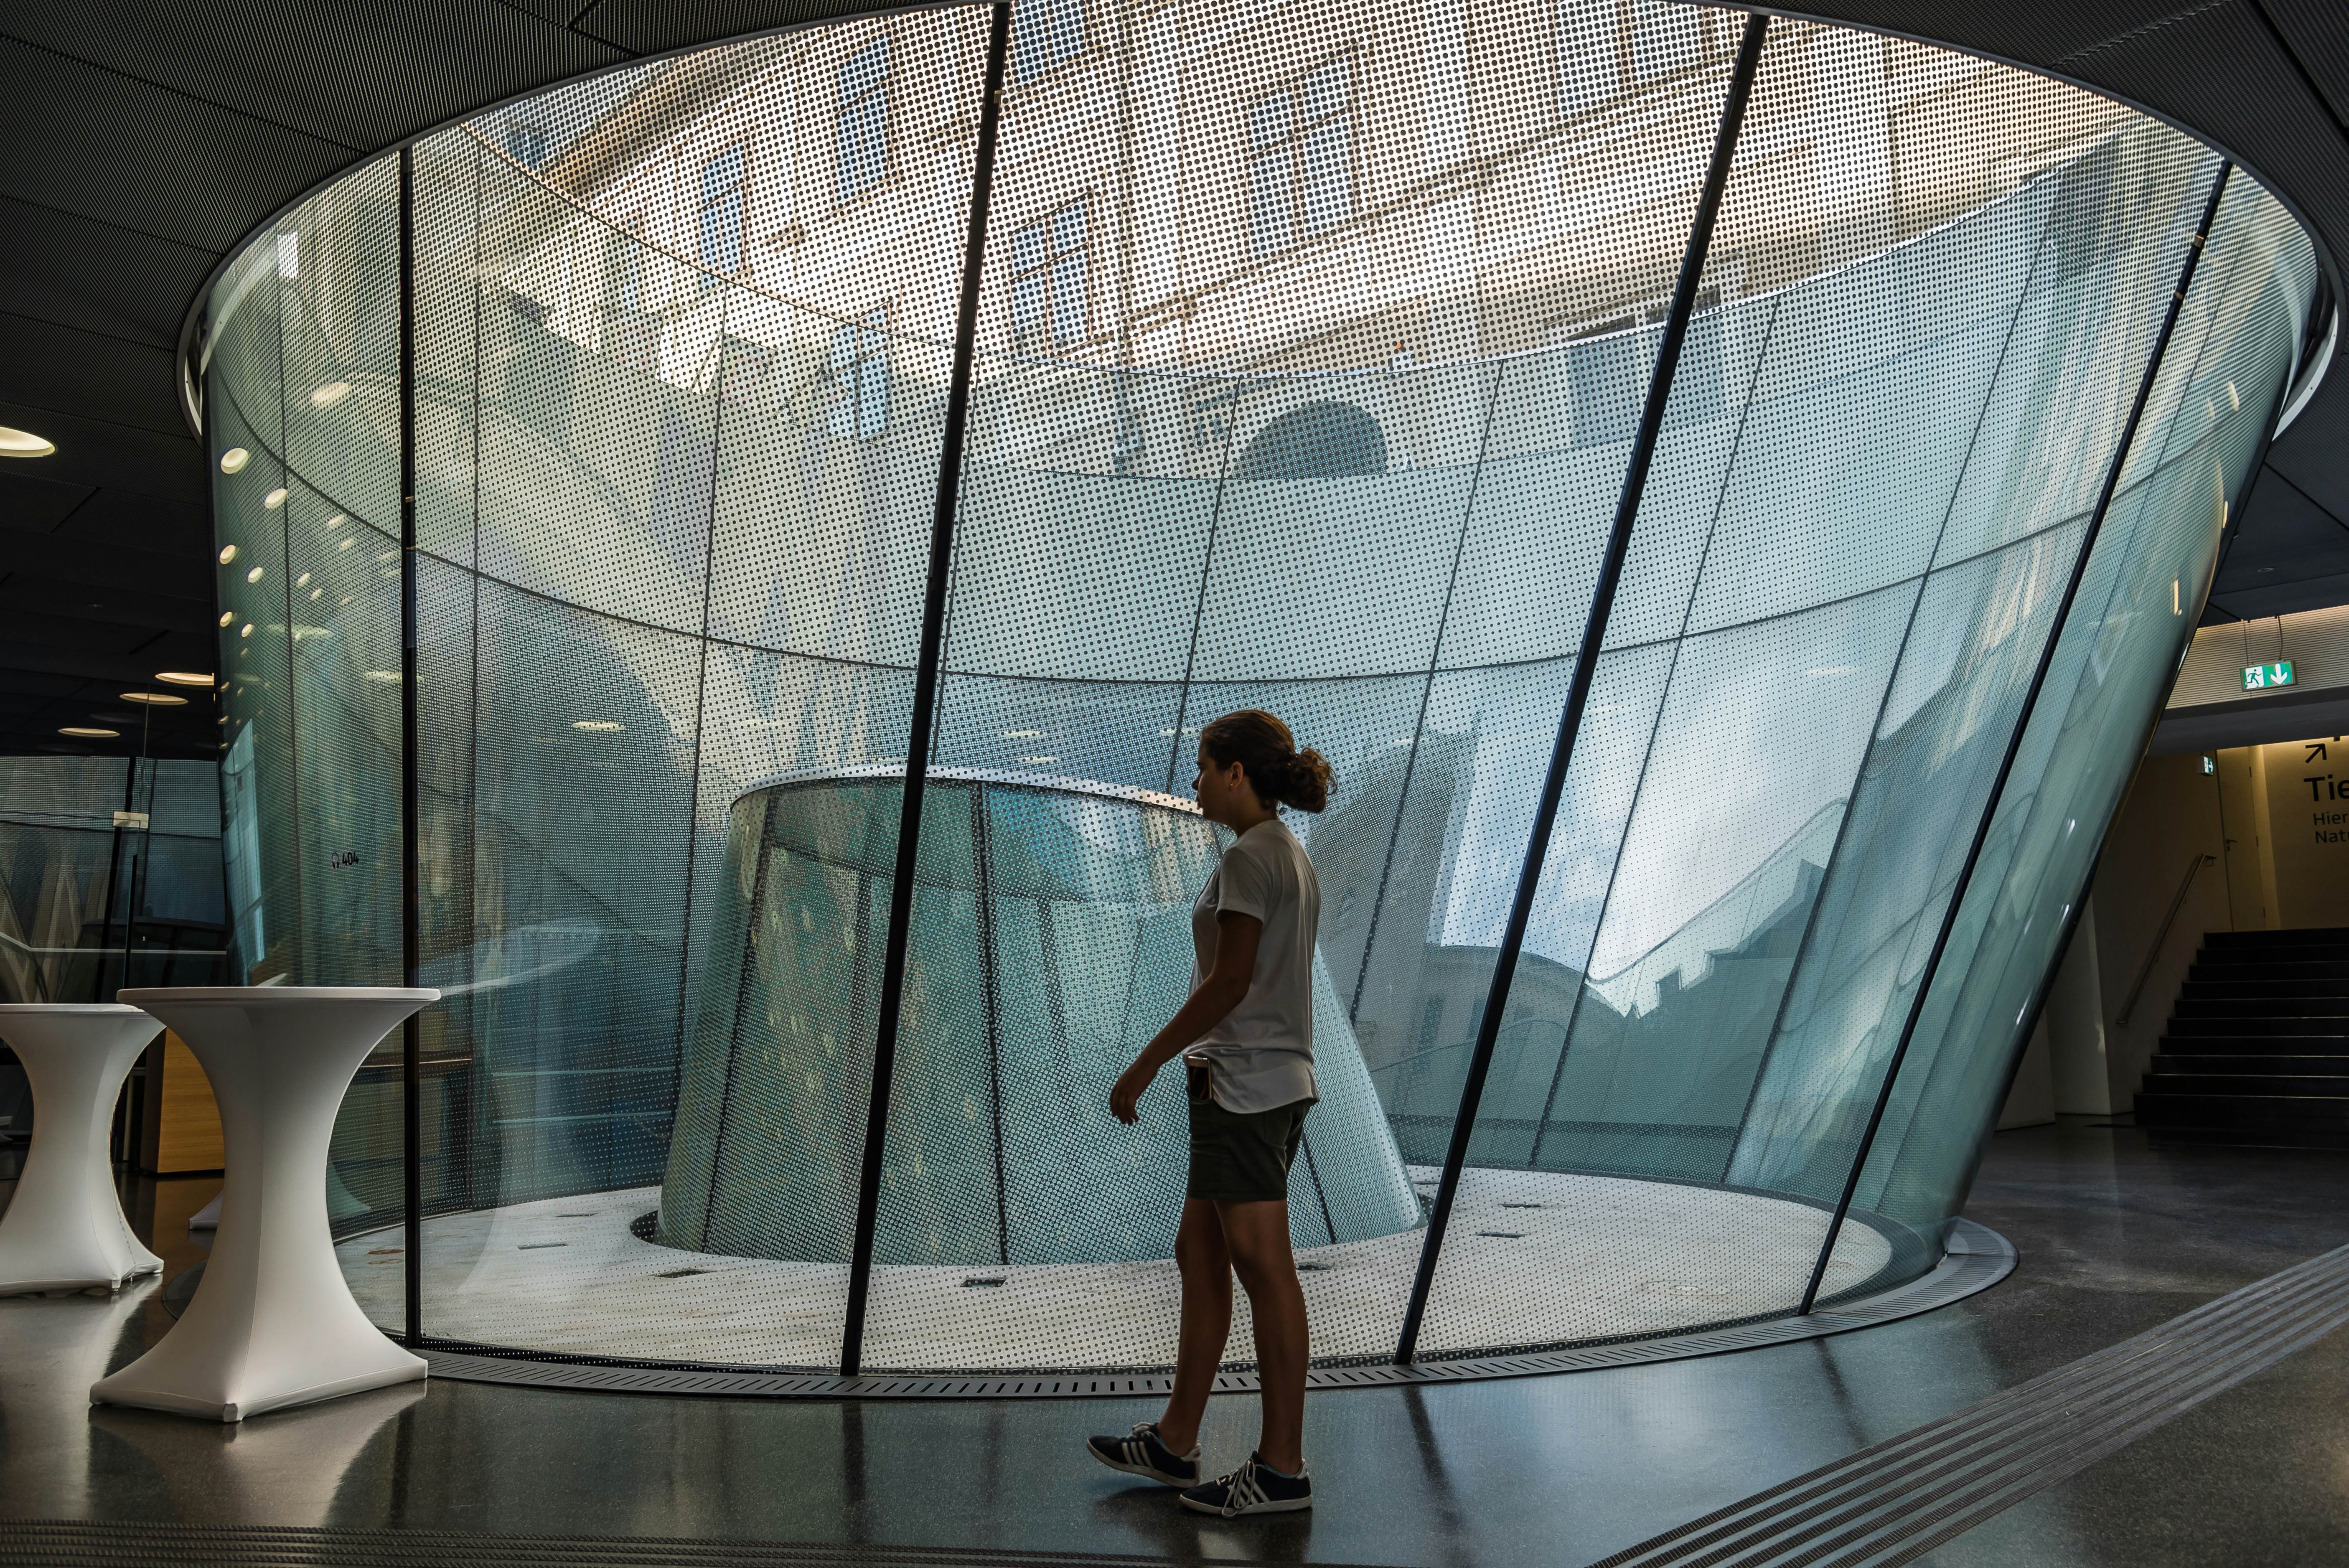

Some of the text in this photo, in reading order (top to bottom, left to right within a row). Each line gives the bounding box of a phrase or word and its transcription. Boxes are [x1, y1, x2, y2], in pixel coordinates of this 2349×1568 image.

[2313, 812, 2348, 826] Hier
[2315, 830, 2349, 844] Nat
[342, 851, 359, 866] 404
